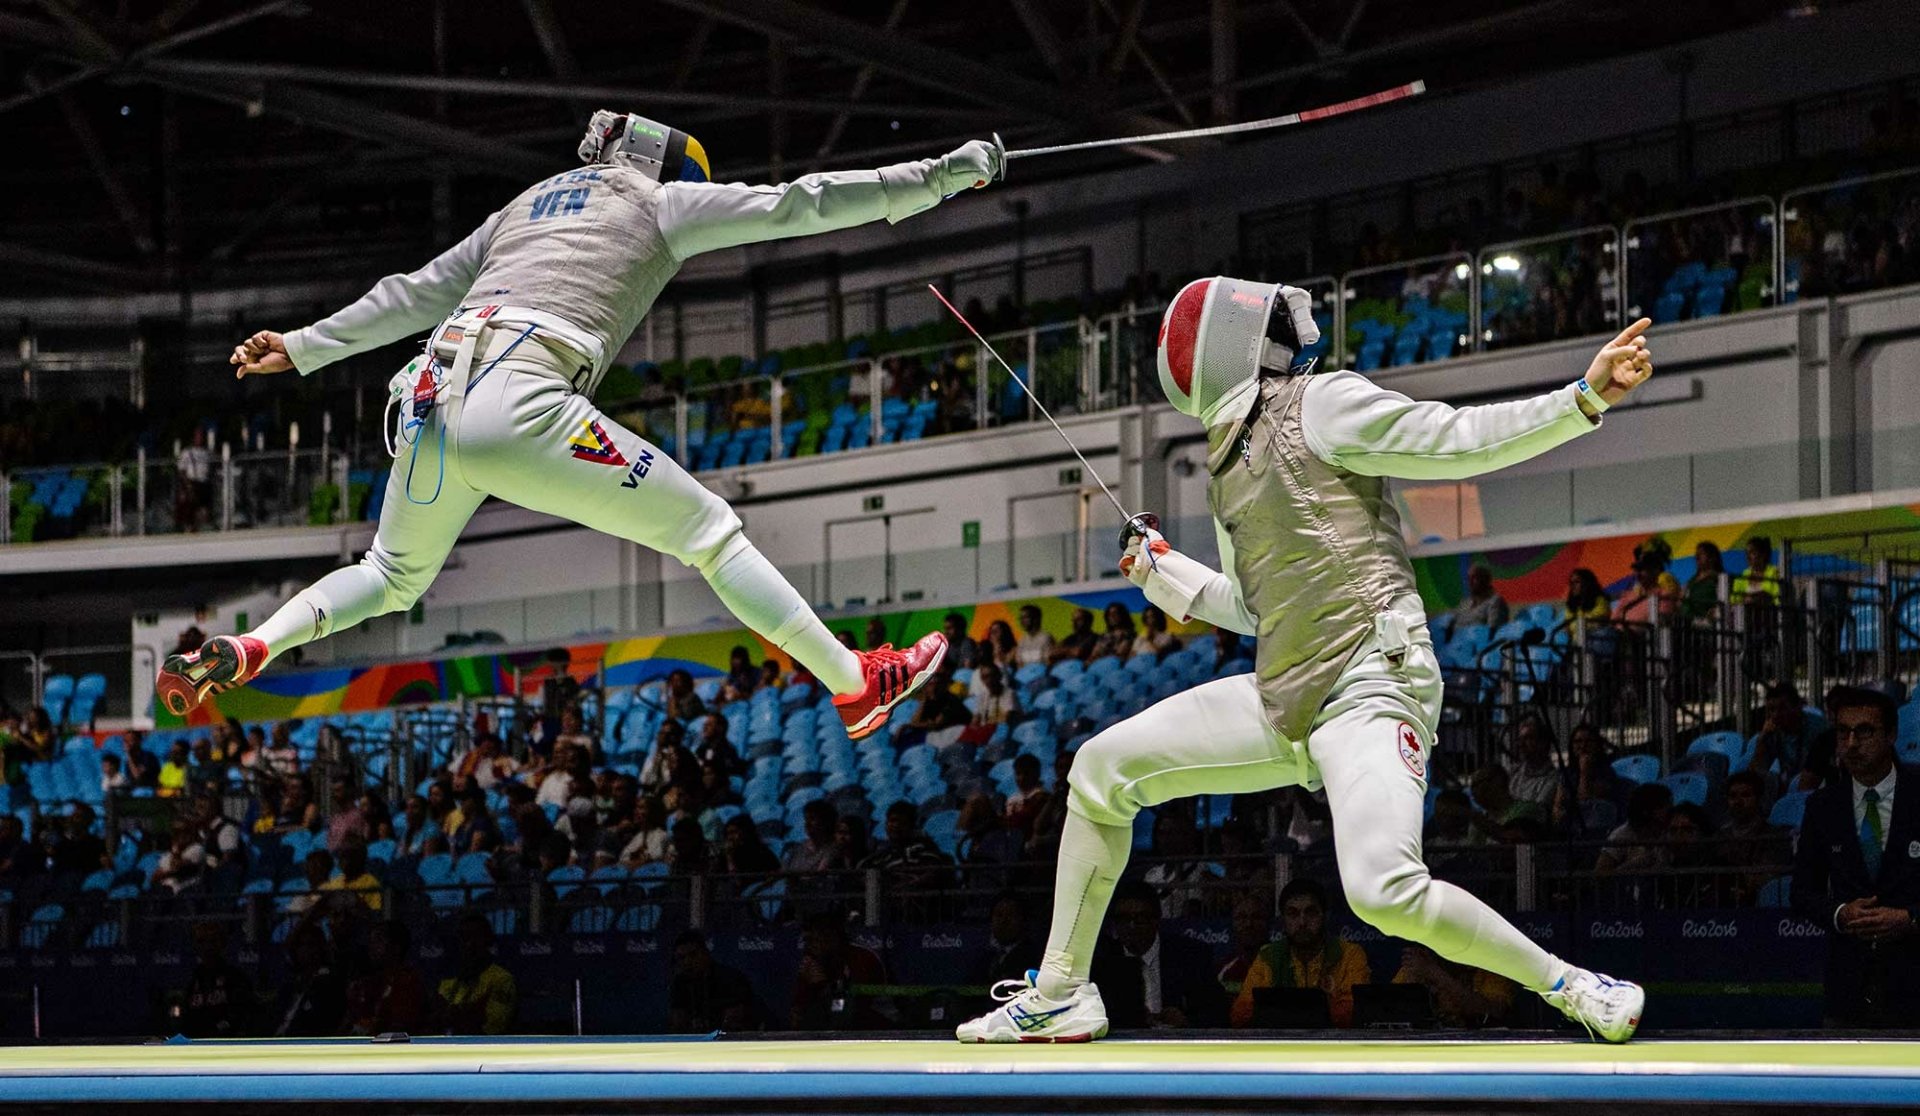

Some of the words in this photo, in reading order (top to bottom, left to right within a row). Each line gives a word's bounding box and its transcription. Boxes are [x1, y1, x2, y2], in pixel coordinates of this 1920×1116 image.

[620, 449, 655, 490] VEN
[1339, 925, 1388, 942] Rio20
[1524, 922, 1555, 939] 2016
[1590, 921, 1645, 939] Rio2016
[1682, 919, 1738, 938] Rio2016
[1777, 918, 1826, 938] Rio20
